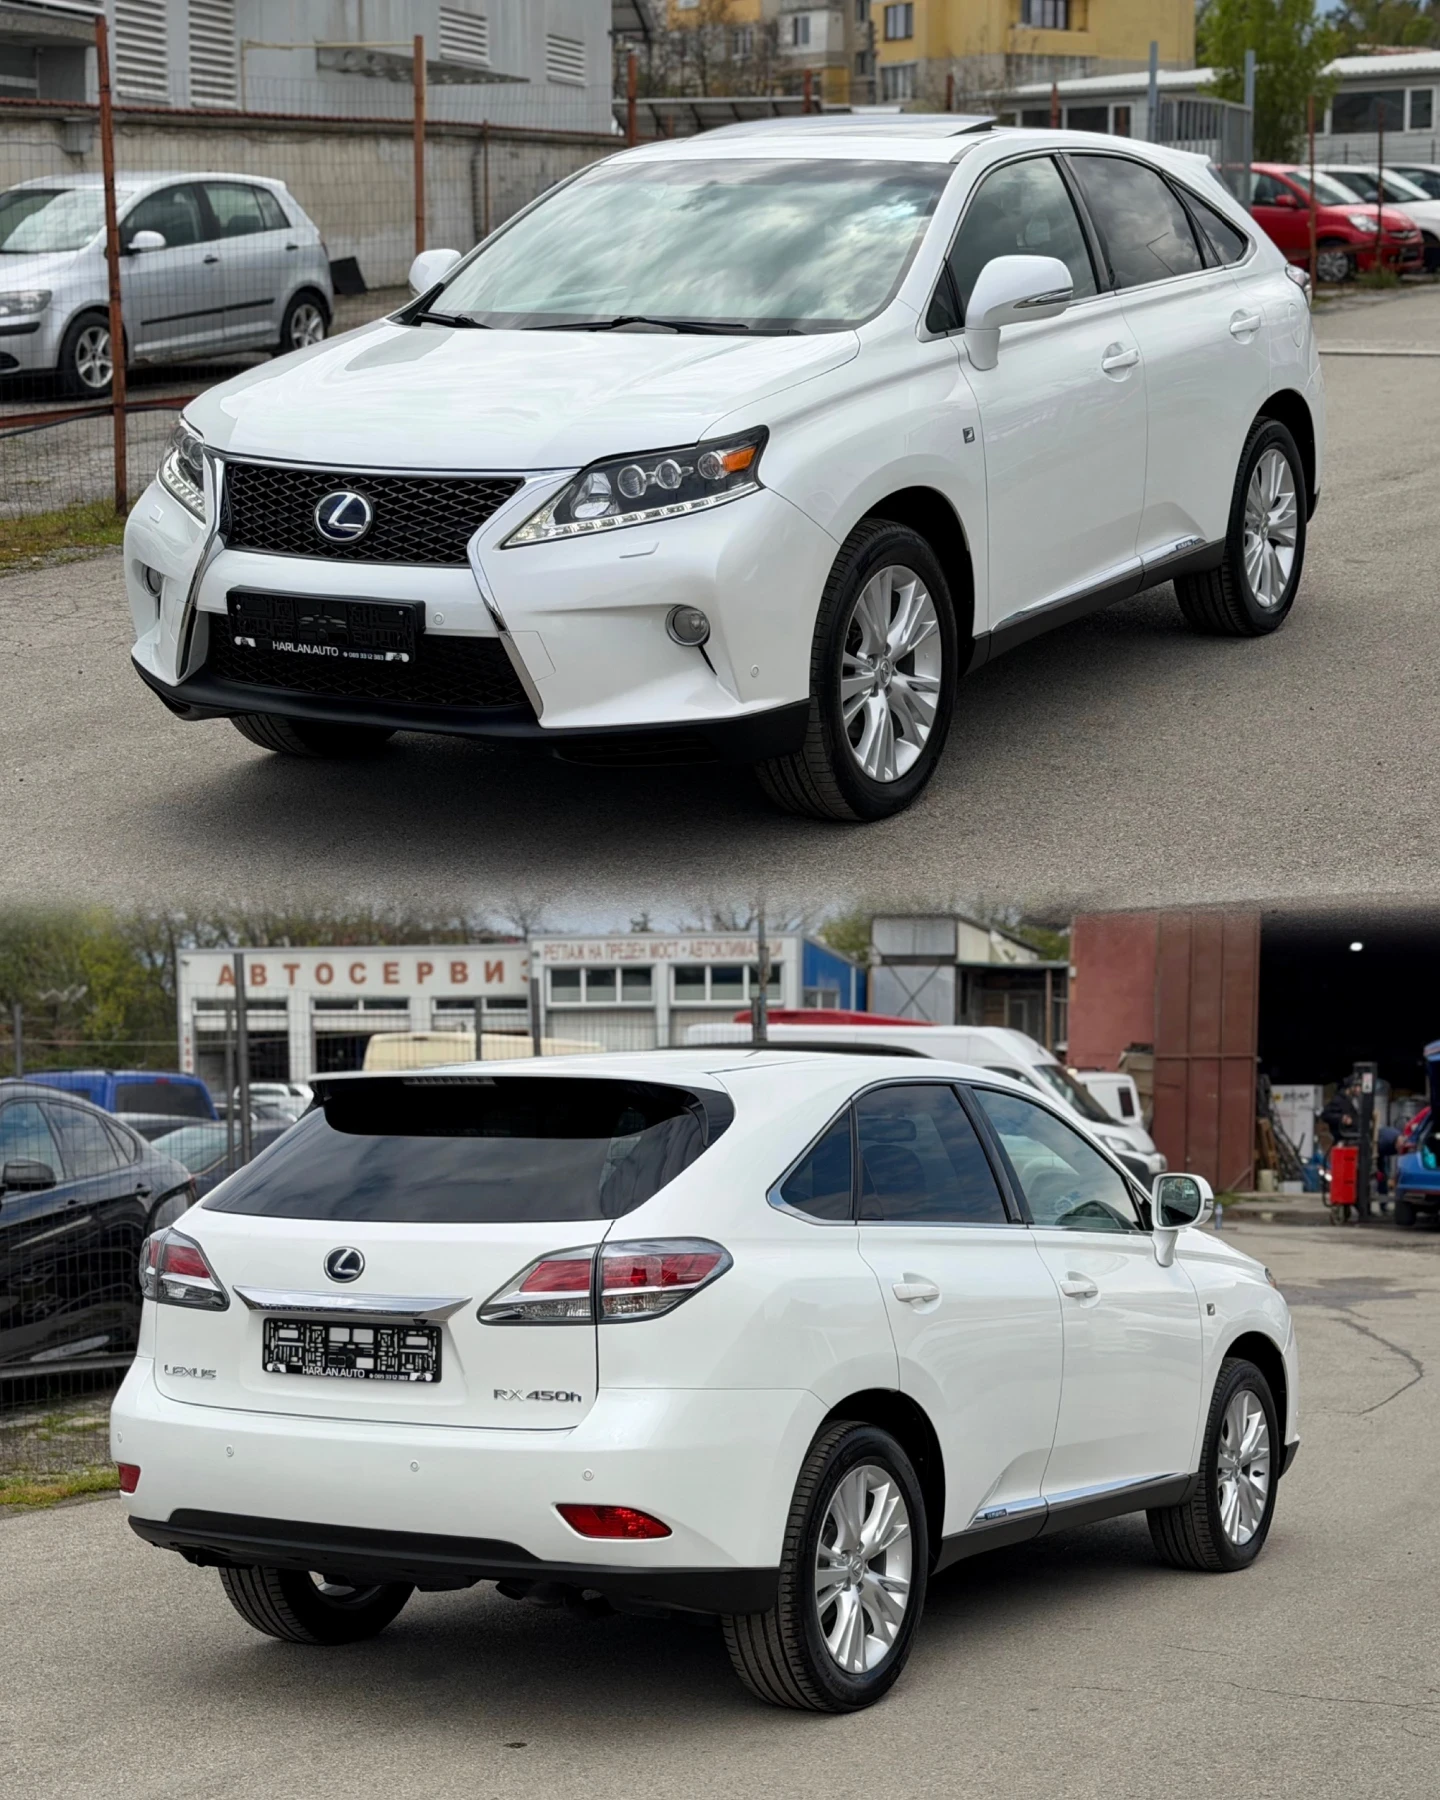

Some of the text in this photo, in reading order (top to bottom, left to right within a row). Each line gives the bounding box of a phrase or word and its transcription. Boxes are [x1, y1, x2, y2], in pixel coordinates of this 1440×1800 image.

[163, 1364, 217, 1380] LEXUS
[493, 1388, 582, 1403] RX 450h
